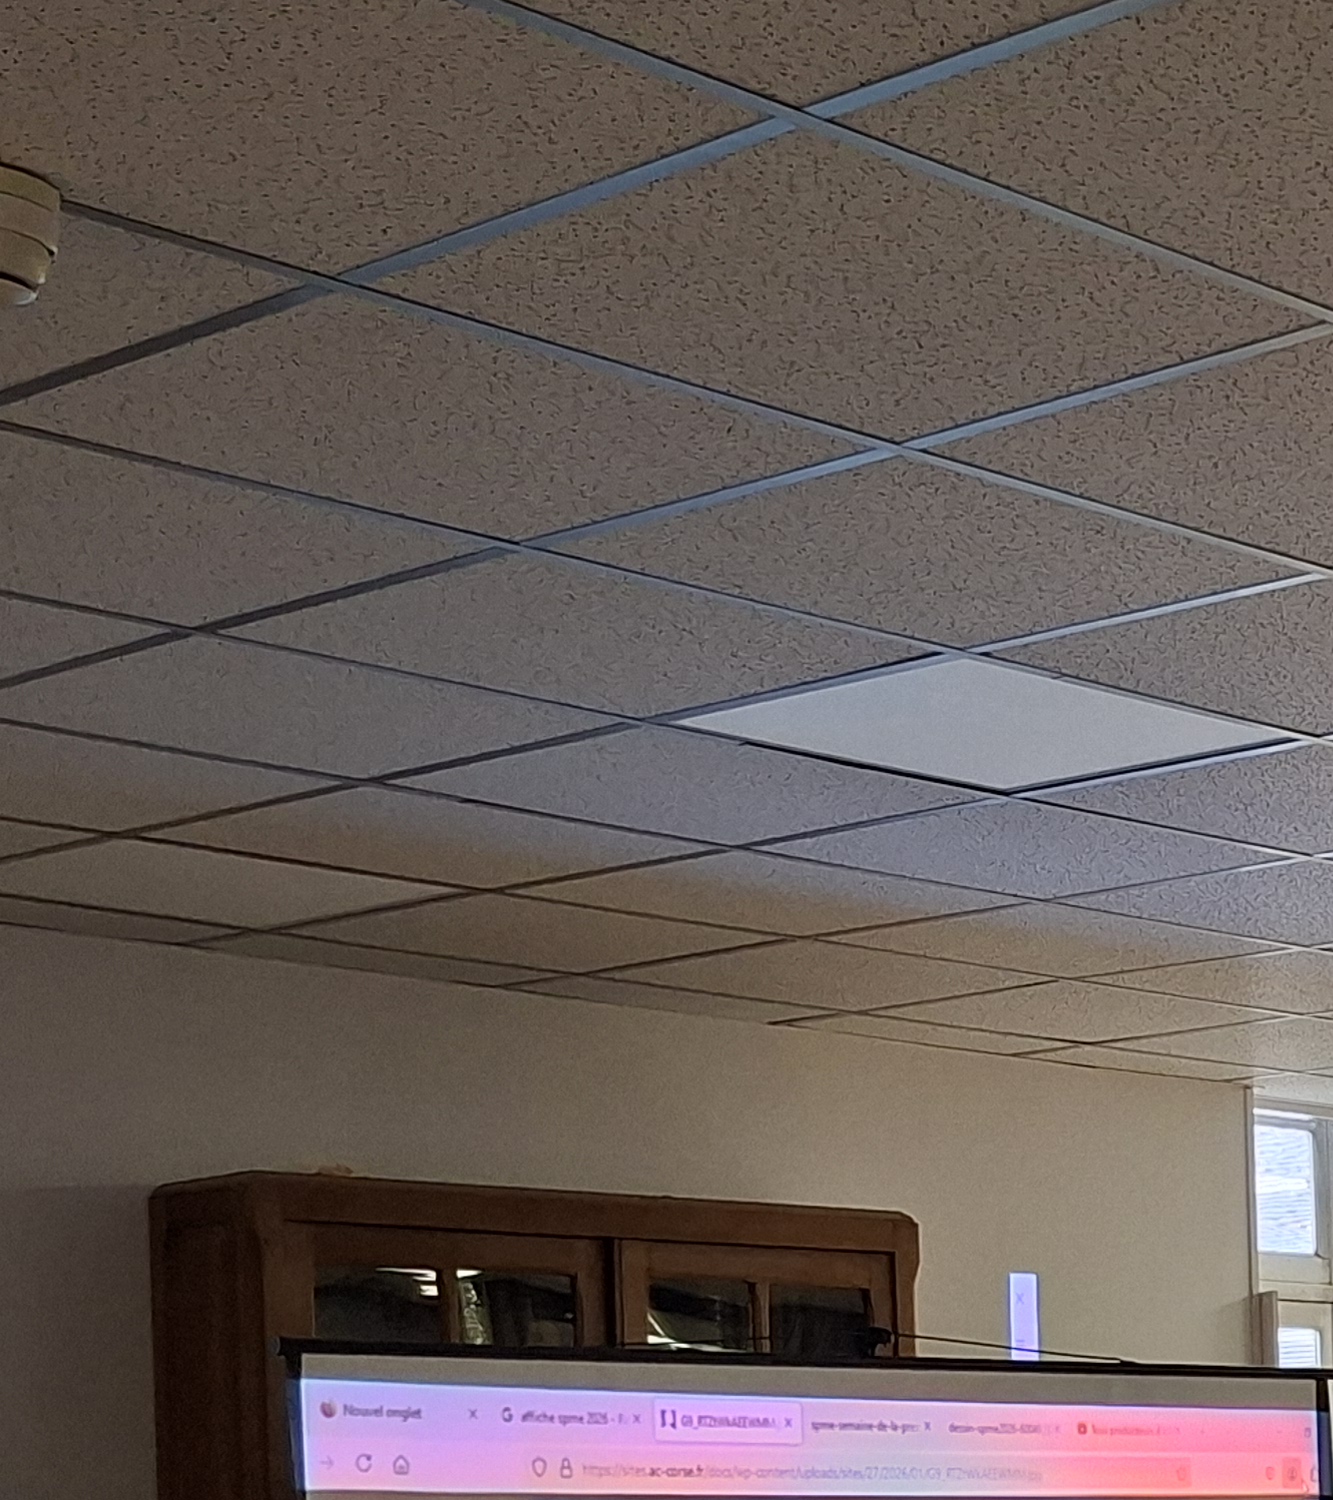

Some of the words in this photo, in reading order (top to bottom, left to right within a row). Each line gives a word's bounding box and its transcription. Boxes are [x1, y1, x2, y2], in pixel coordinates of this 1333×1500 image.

[343, 1403, 384, 1418] Nouvel
[385, 1406, 422, 1422] onglet
[521, 1411, 555, 1424] affiche
